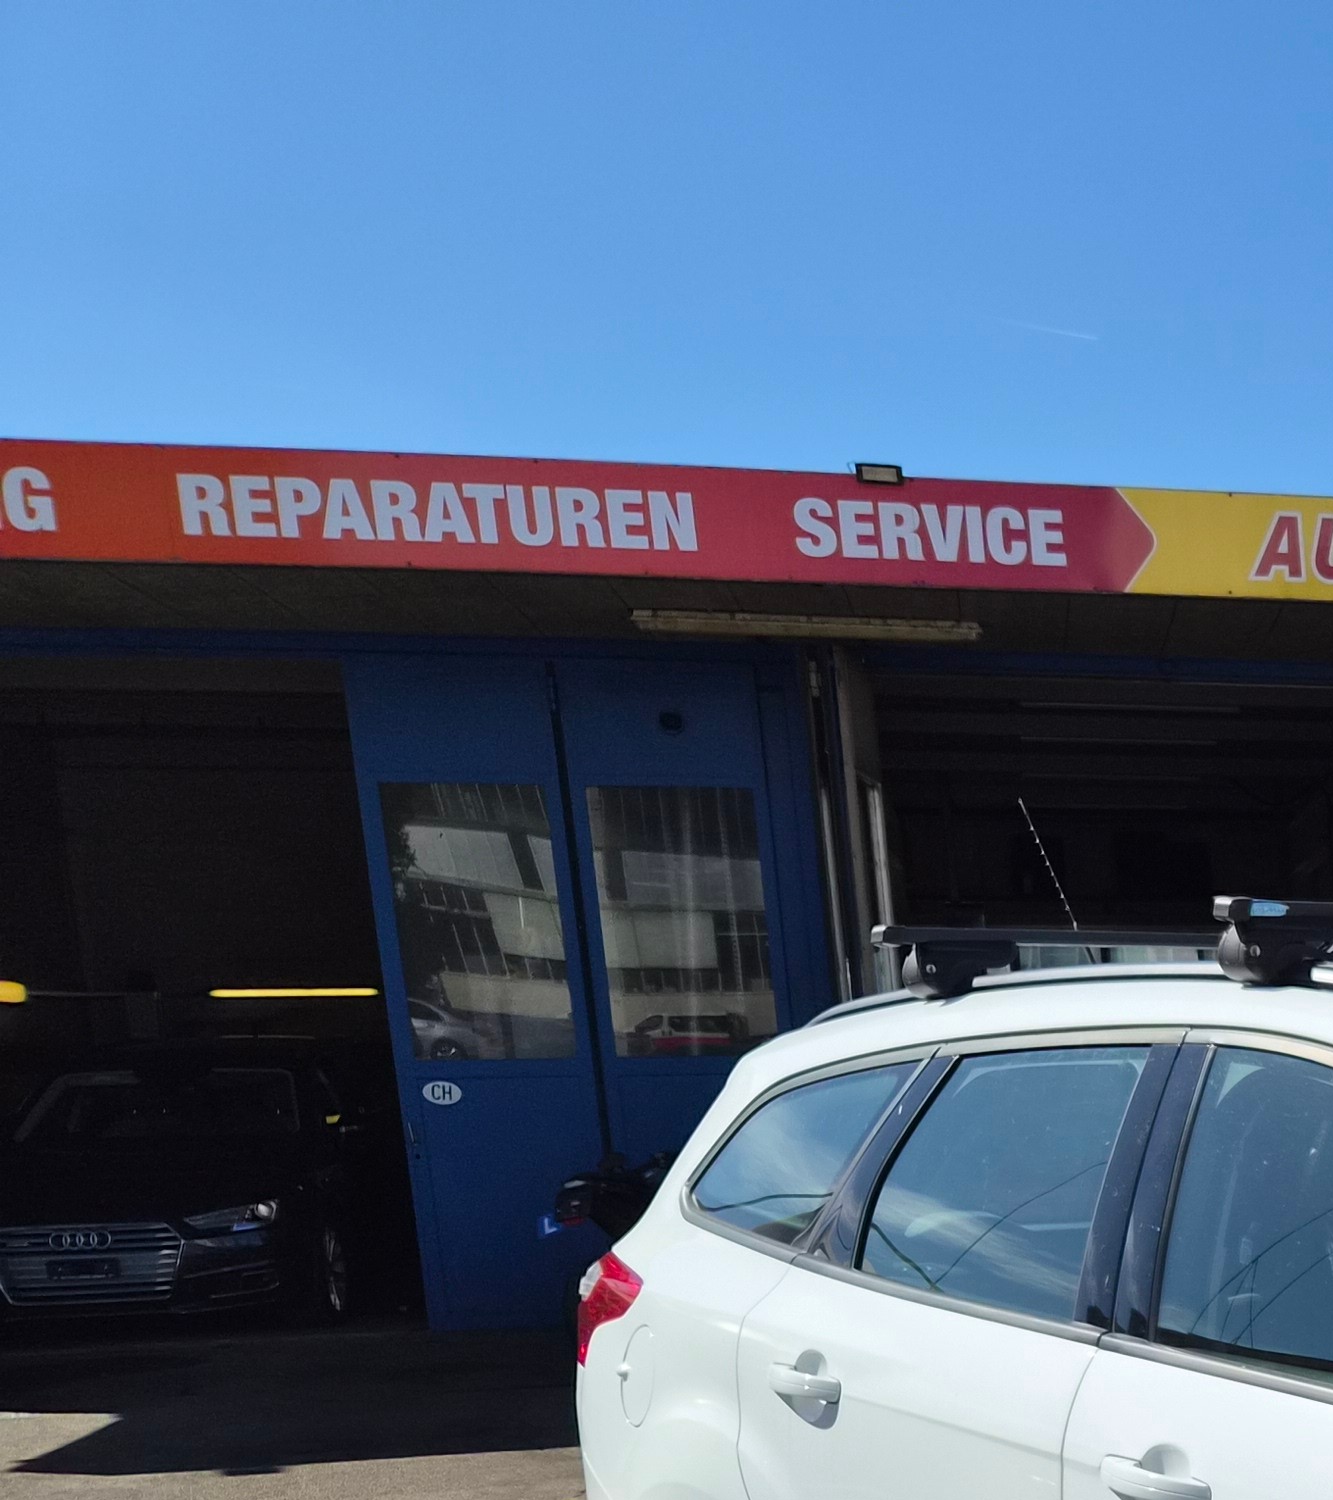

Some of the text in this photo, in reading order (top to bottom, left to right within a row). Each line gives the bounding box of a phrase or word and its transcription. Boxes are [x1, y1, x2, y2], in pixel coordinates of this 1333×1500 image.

[0, 466, 57, 532] G
[176, 472, 699, 552] REPARATUREN
[793, 496, 1068, 567] SERVICE
[431, 1084, 453, 1101] CH
